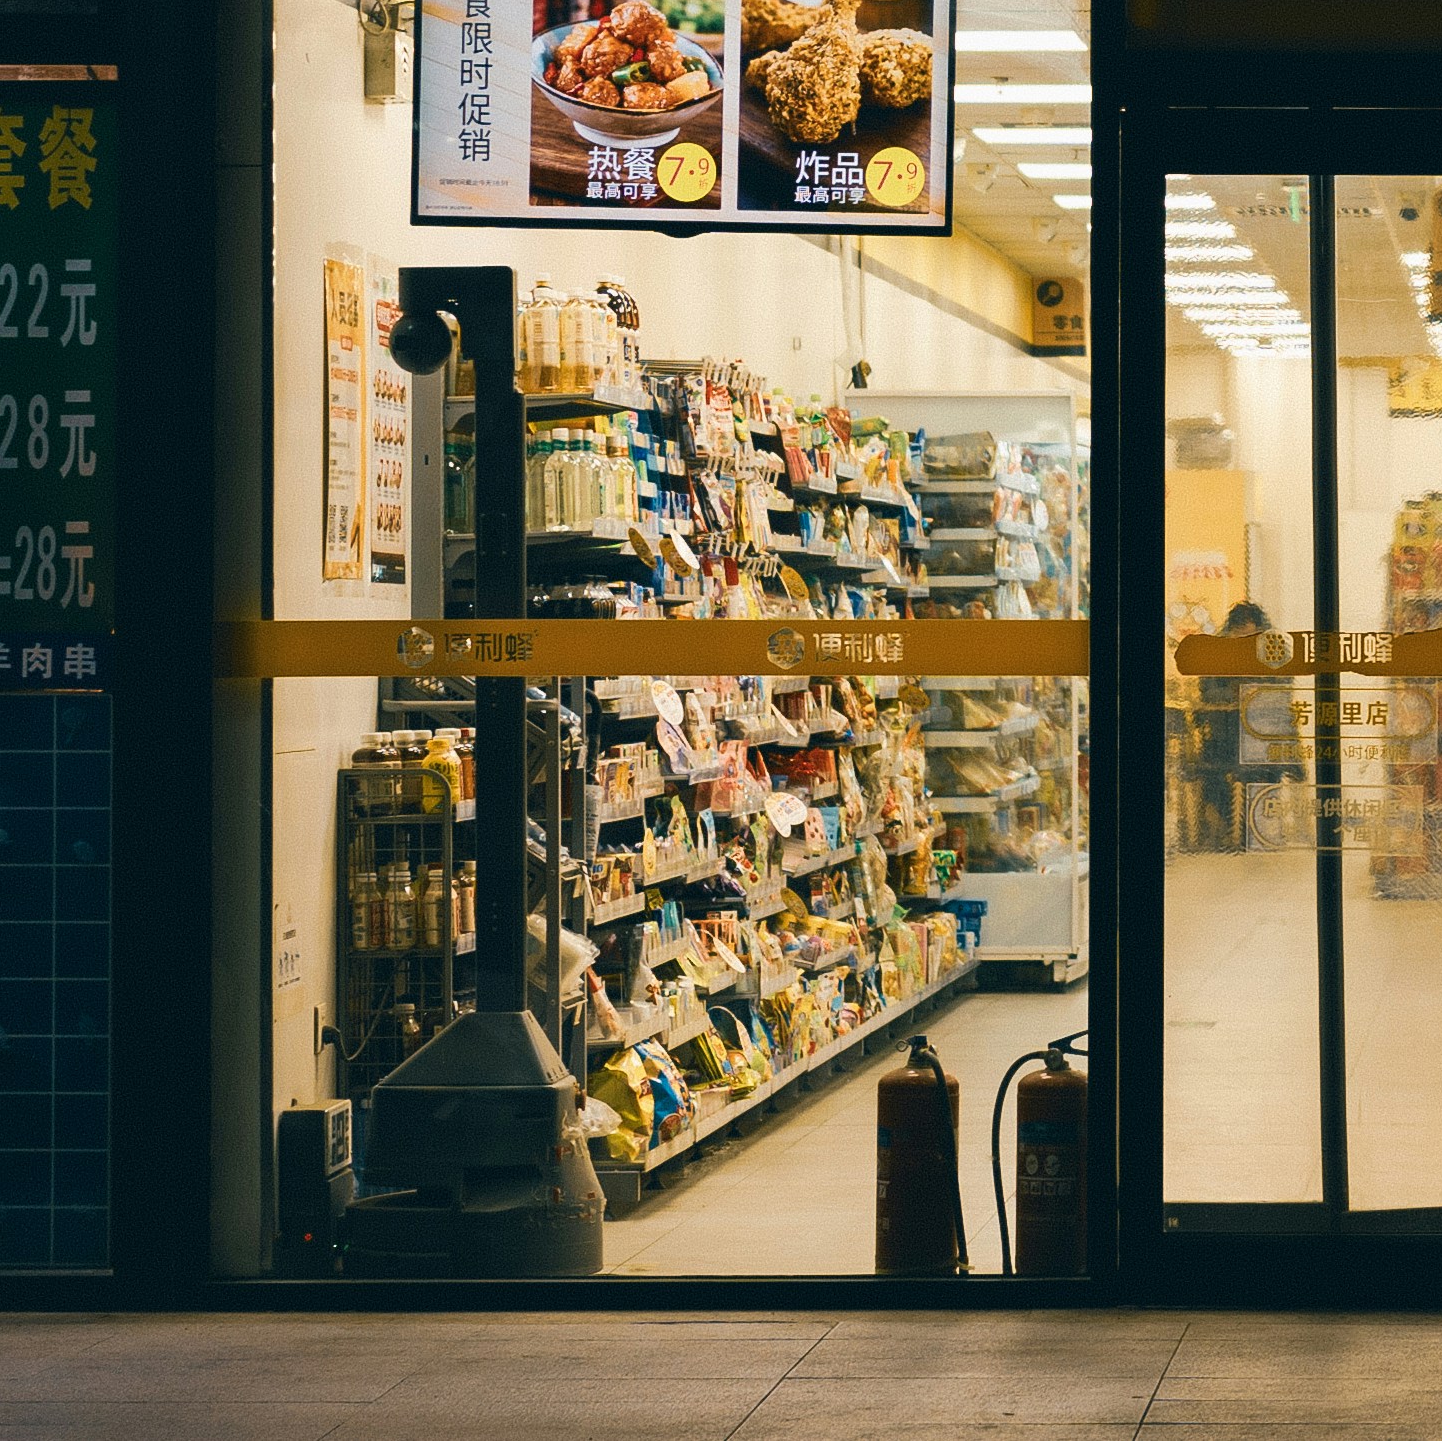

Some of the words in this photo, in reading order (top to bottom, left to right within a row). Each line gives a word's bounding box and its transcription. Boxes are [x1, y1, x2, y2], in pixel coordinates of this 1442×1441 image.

[587, 146, 655, 181] 热餐
[795, 150, 864, 185] 炸品
[586, 182, 658, 200] 最高可享
[794, 186, 866, 204] 最高可享
[813, 632, 904, 663] 便利蜂
[1302, 632, 1393, 664] 便利蜂
[1290, 701, 1388, 726] 芳源里店
